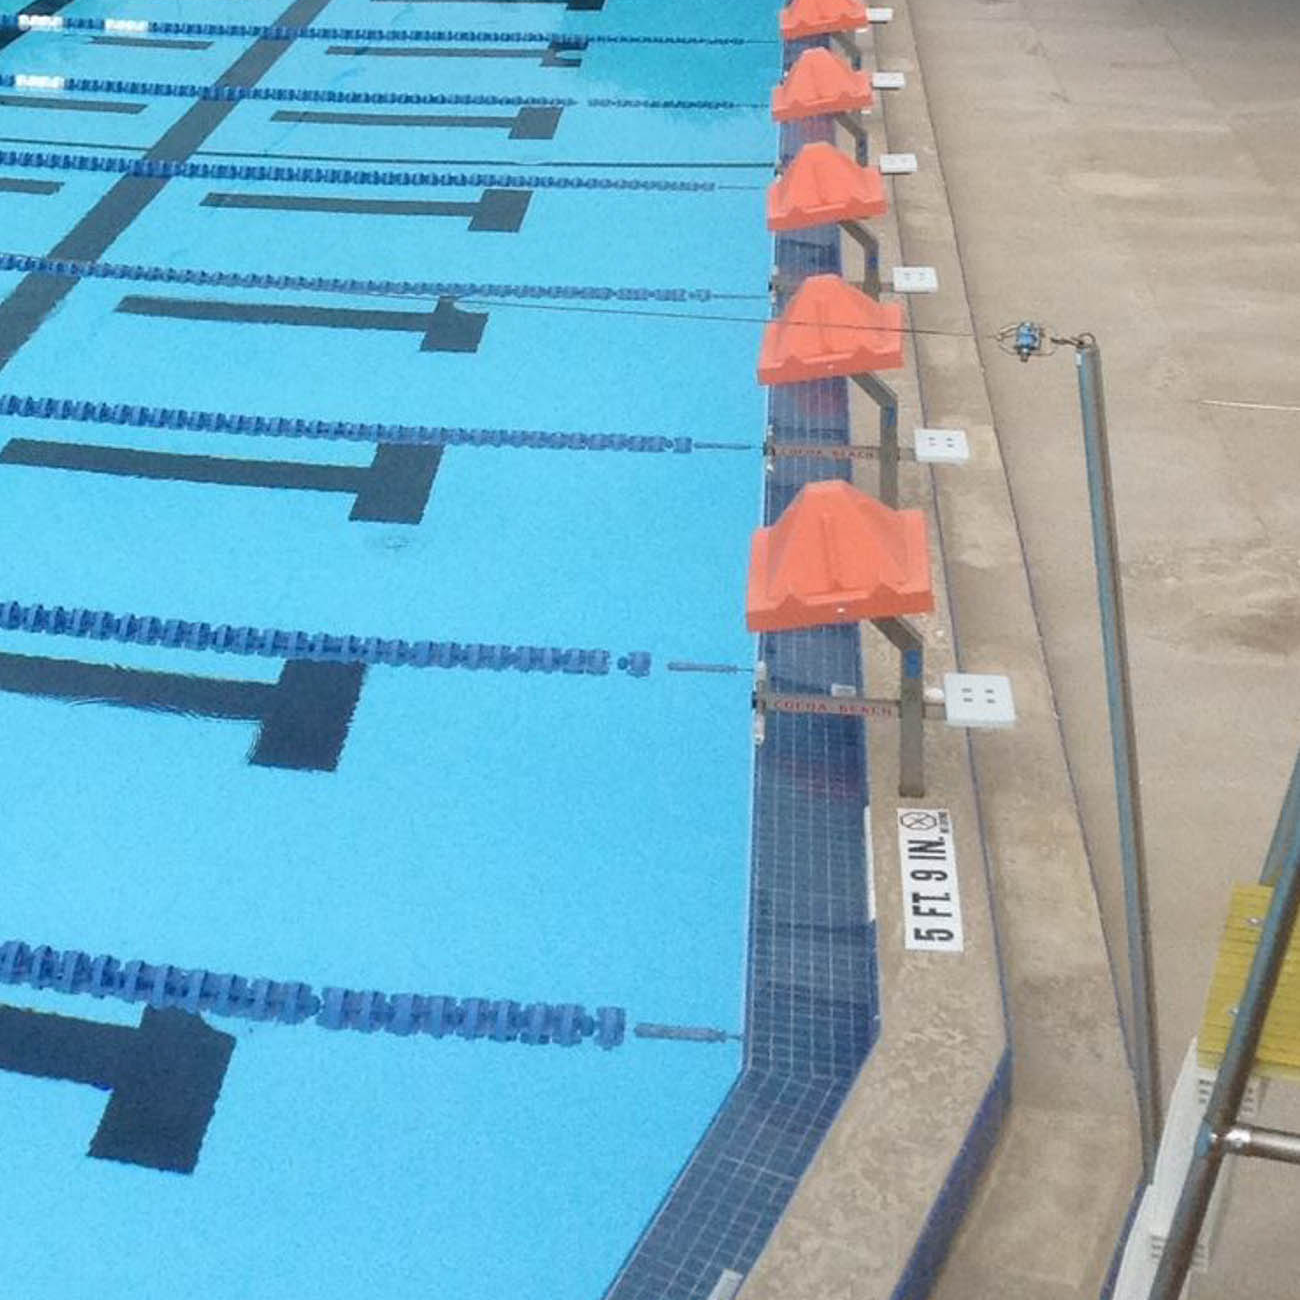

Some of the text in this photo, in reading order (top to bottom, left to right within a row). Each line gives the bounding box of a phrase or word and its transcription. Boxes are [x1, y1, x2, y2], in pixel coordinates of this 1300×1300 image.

[908, 836, 947, 860] IN.
[910, 869, 948, 881] 9
[913, 928, 954, 941] 5
